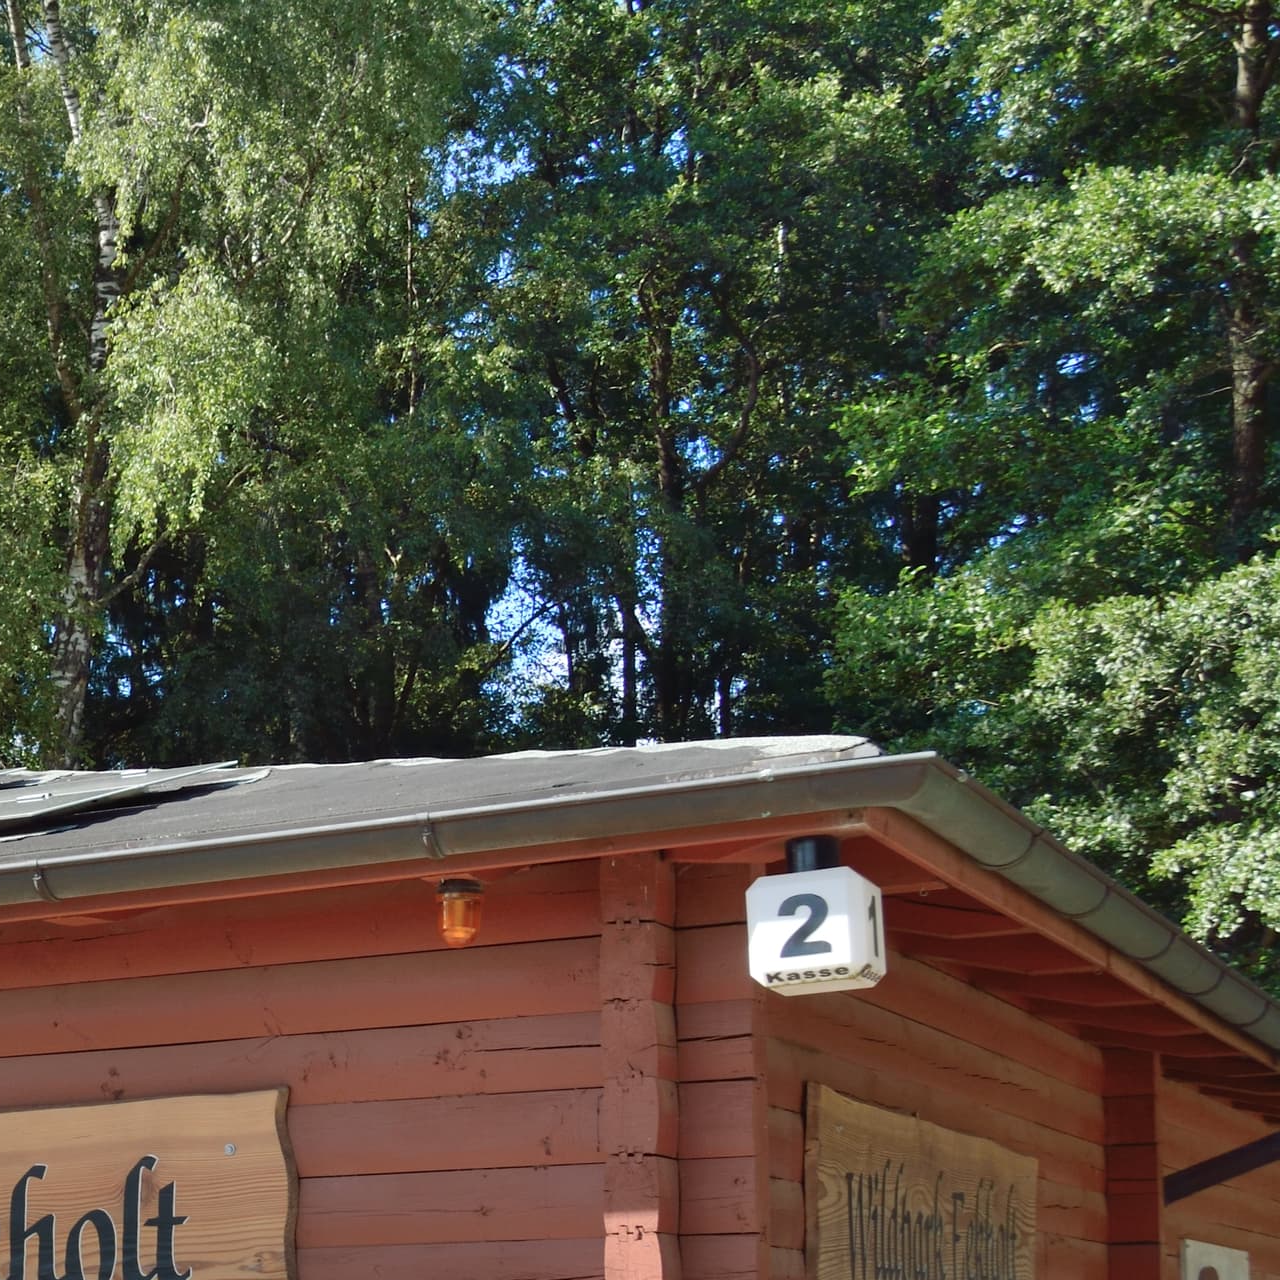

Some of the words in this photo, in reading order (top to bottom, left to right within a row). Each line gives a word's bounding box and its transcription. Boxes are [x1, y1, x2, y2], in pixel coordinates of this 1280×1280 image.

[777, 893, 833, 958] 2
[868, 895, 879, 958] 1
[765, 966, 849, 983] Kasse
